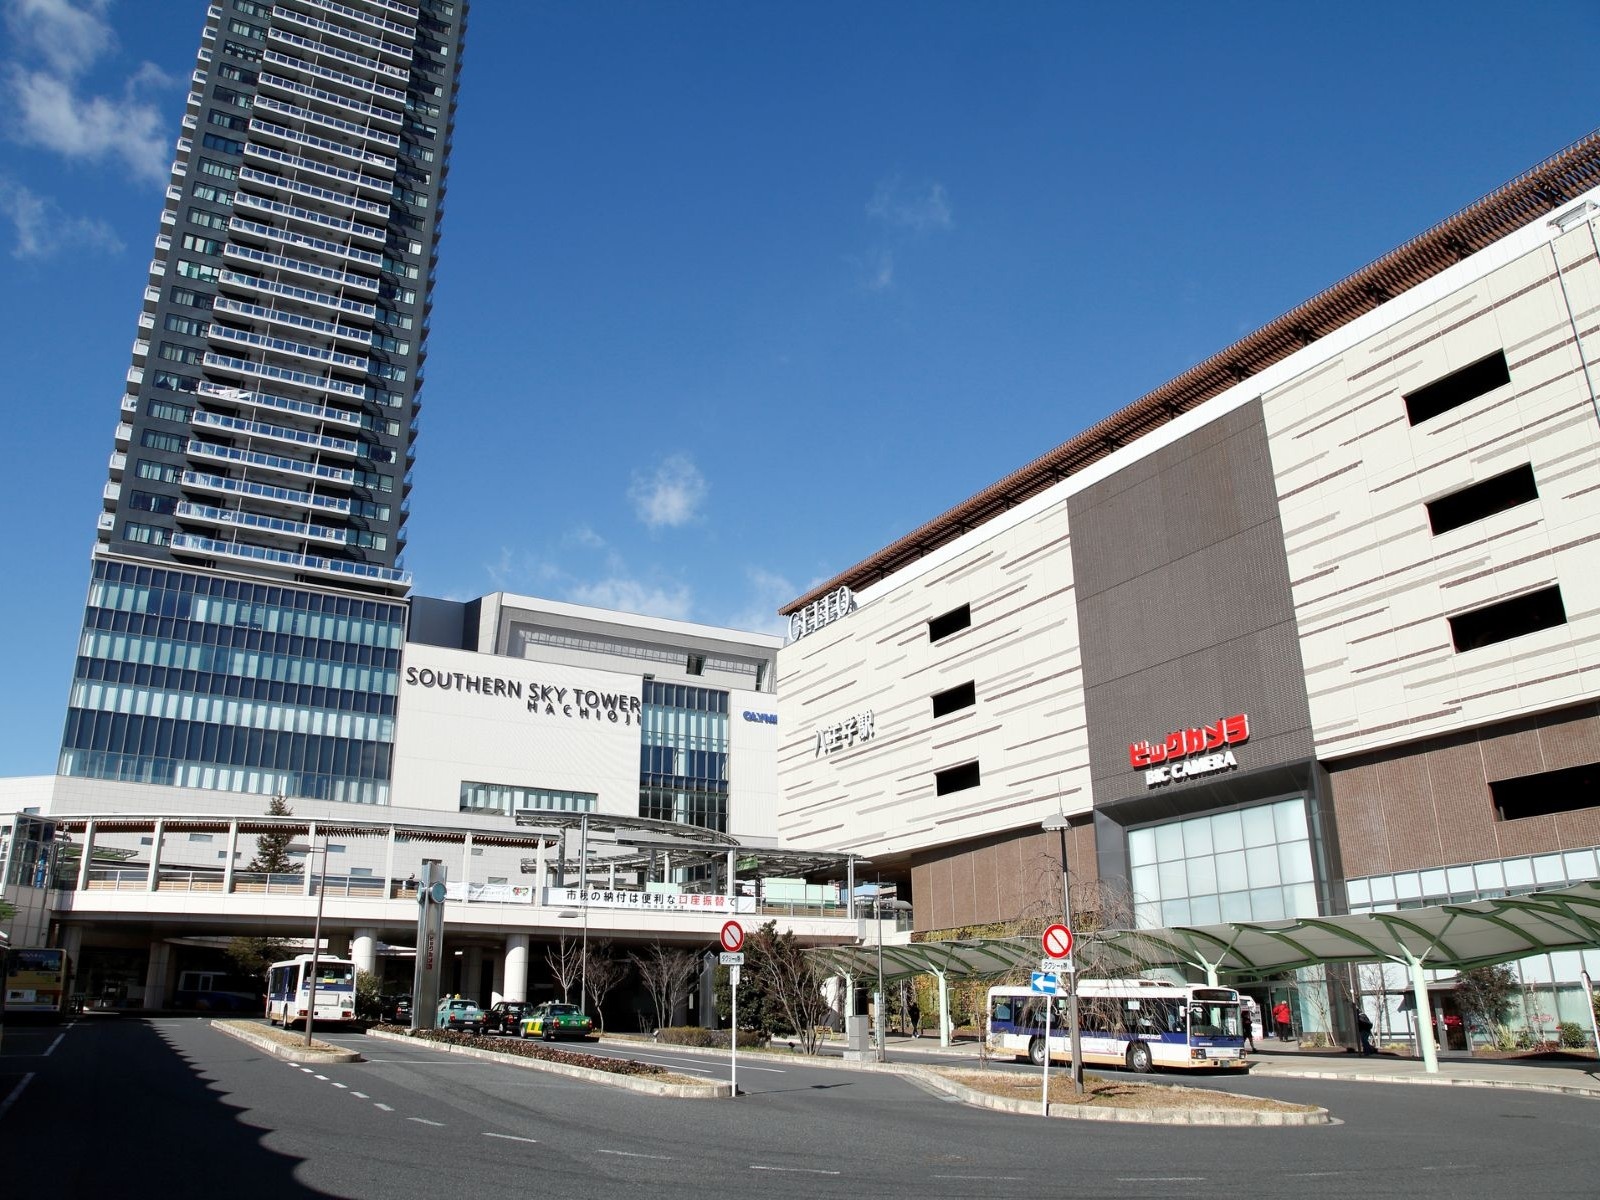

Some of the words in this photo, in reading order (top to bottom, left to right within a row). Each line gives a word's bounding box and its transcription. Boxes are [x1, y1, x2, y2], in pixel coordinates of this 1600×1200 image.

[406, 666, 523, 700] SOUTHERN
[528, 682, 568, 705] SKY
[573, 688, 642, 714] TOWER
[527, 699, 642, 727] HACHIOJI
[815, 709, 875, 759] 八王子駅
[1145, 766, 1171, 788] BIC
[1171, 751, 1238, 780] CAMERA
